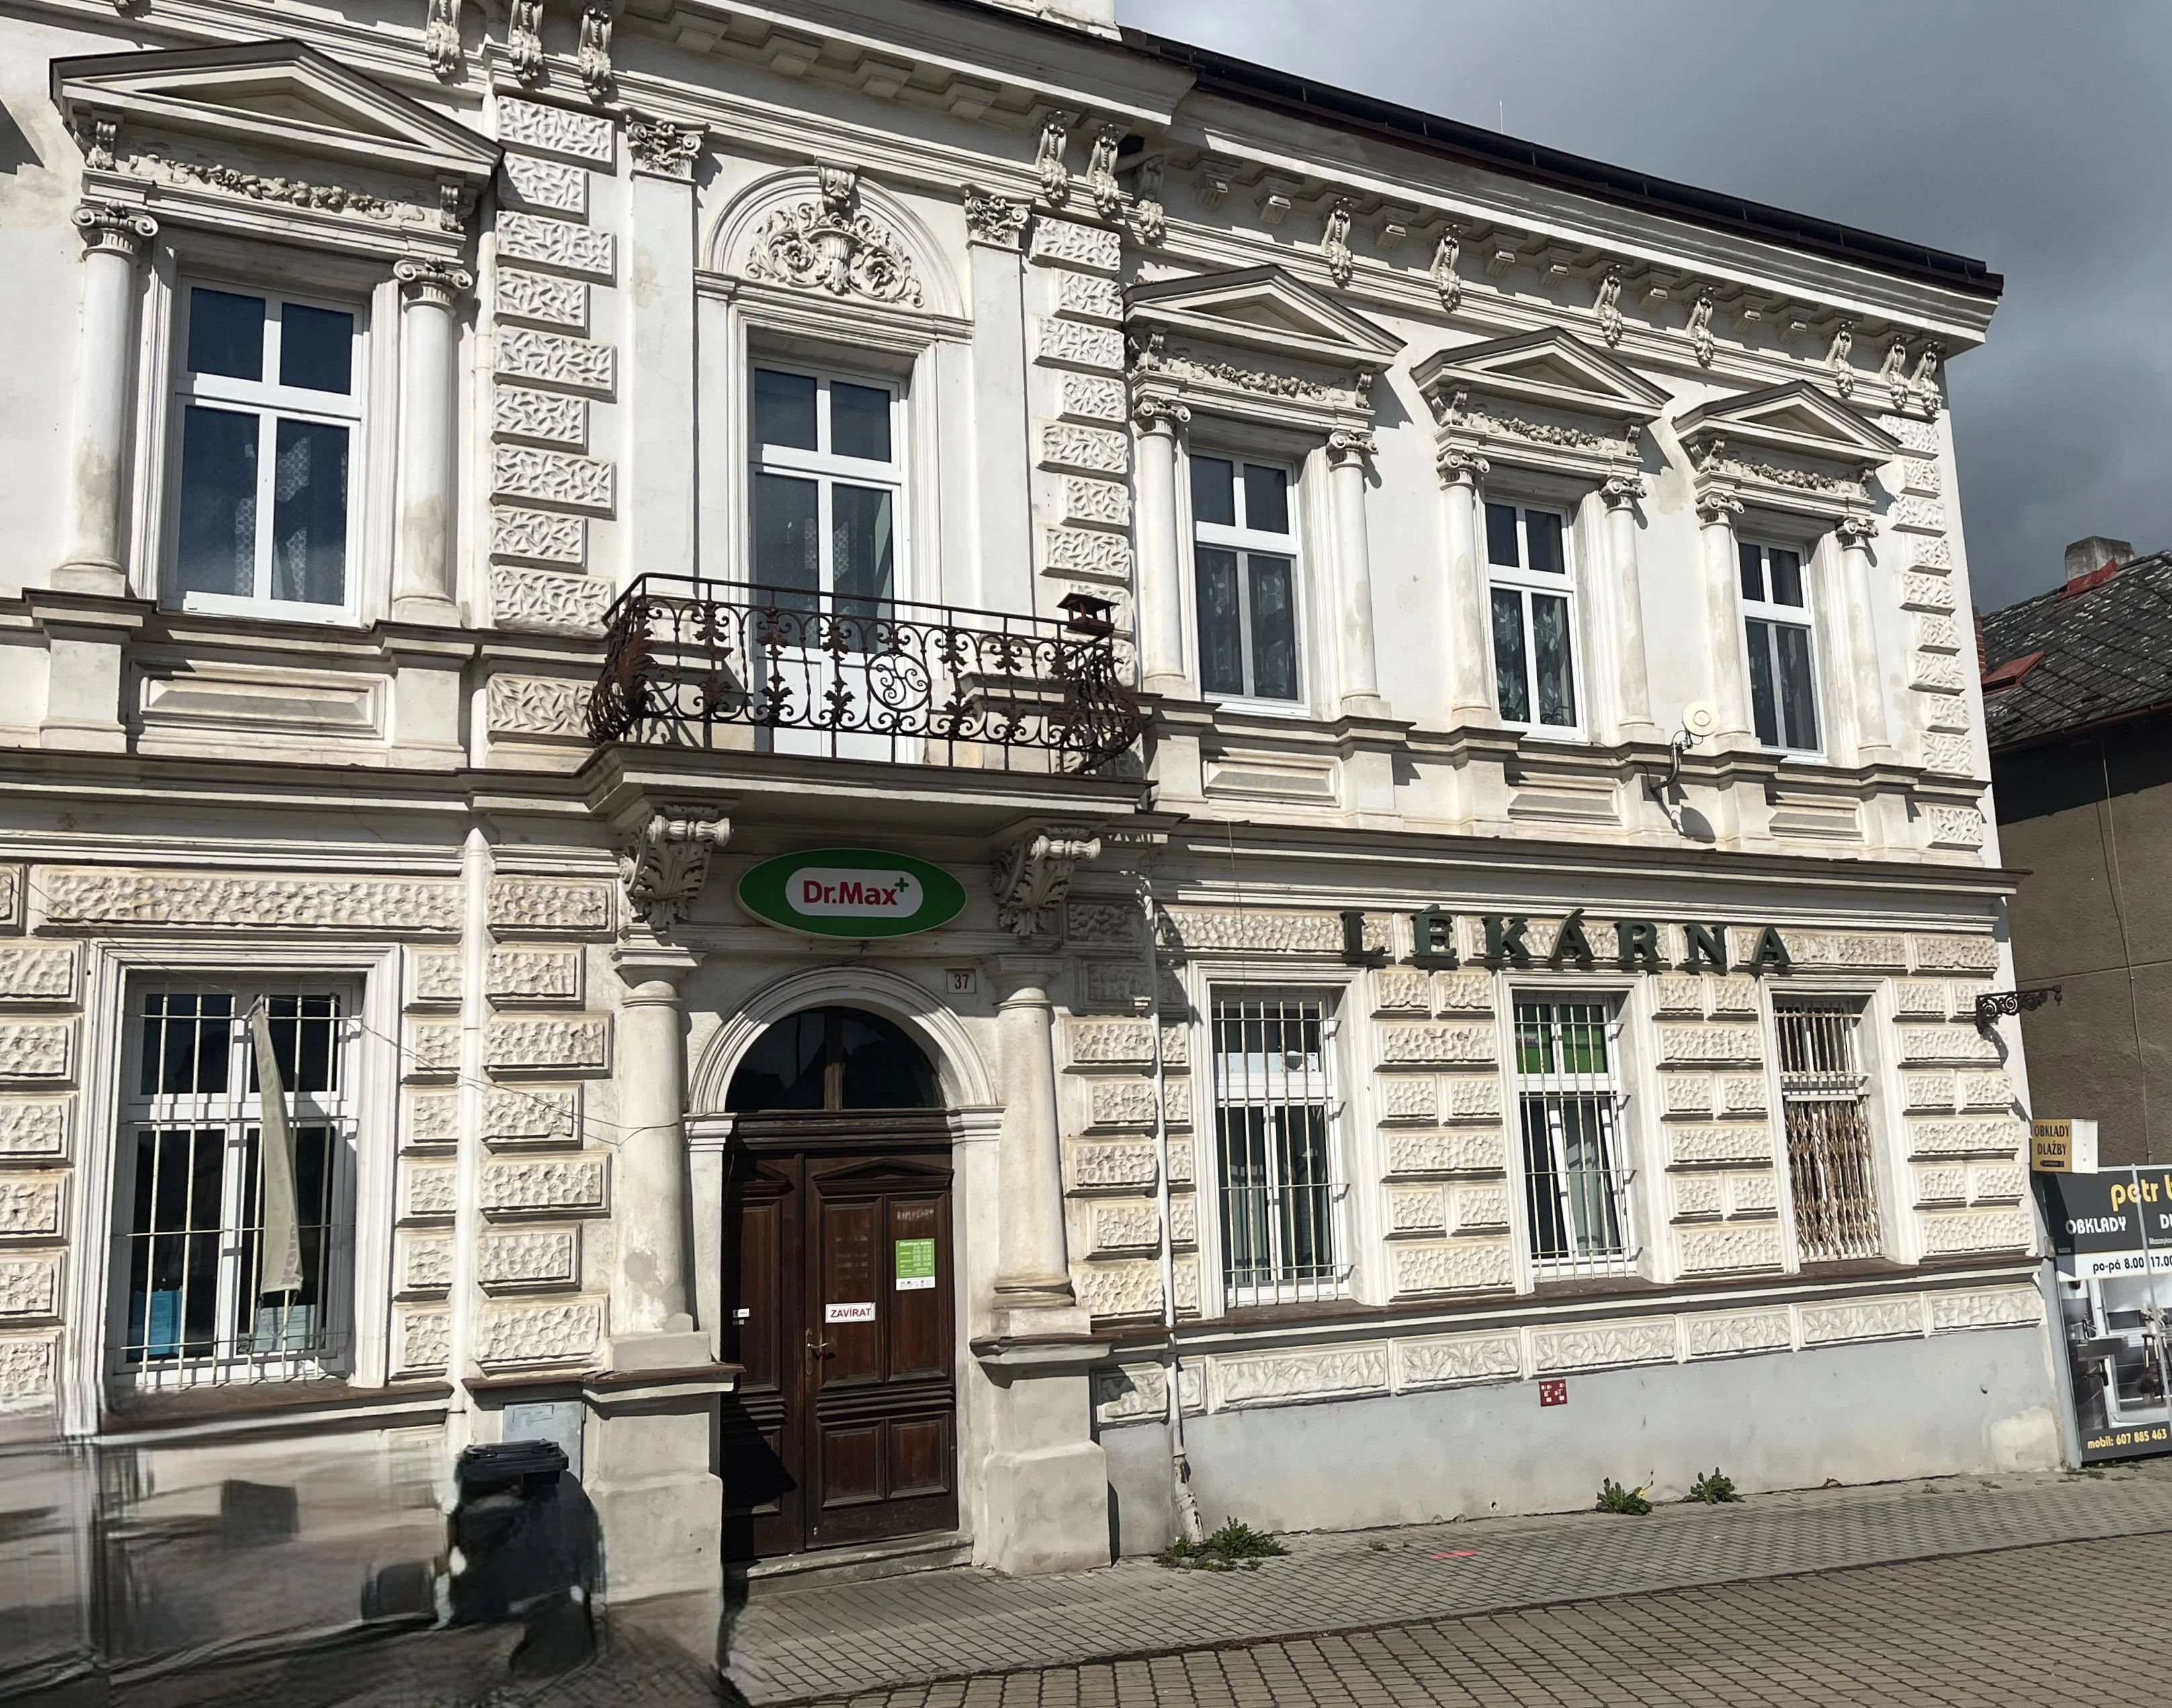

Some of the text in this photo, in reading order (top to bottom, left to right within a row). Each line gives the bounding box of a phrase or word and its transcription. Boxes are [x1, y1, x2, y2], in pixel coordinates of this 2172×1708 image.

[1339, 903, 1793, 967] LÉKÁRNA
[954, 973, 969, 989] 37
[2034, 1125, 2070, 1137] OBKLADY
[2037, 1139, 2067, 1155] DLAŽBY
[2065, 1216, 2127, 1235] OBKLADY
[2093, 1259, 2122, 1274] po-pá
[2124, 1257, 2144, 1269] 8.00
[830, 1307, 871, 1318] ZAVÍRAT
[2087, 1428, 2167, 1449] mobil: 607 885 463
